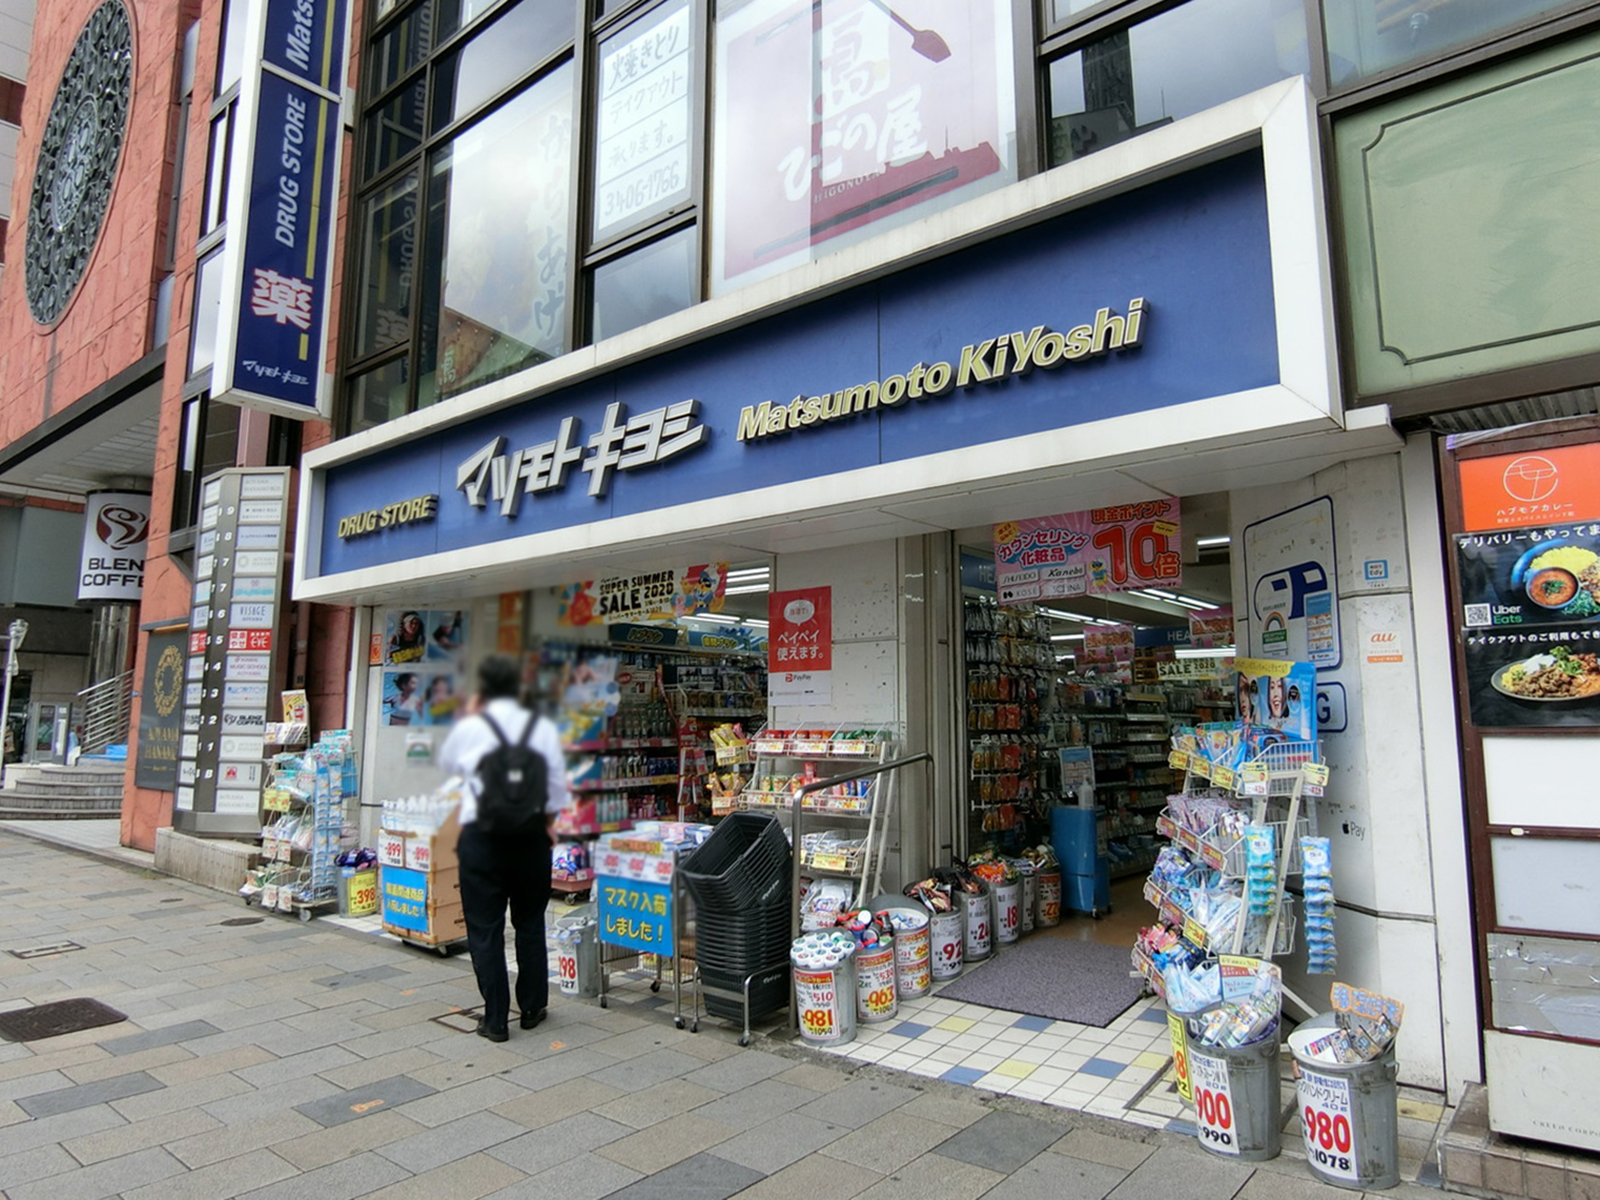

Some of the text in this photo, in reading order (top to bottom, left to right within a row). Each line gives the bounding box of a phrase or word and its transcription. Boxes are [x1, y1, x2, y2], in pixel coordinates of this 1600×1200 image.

[608, 26, 680, 91] 焼きとり
[609, 71, 683, 123] テイクアウト
[777, 84, 928, 202] ひごの屋
[275, 93, 308, 248] DRUG STORE
[251, 267, 314, 330] 薬
[242, 359, 310, 386] マツモトキヨシ
[736, 297, 1151, 443] Matsumoto KiYoshi
[456, 399, 711, 518] マツモトキヨシ
[337, 494, 438, 540] DRUG STORE
[1091, 500, 1171, 523] 現金ポイント
[998, 528, 1091, 561] カウンセリング
[88, 558, 145, 571] BLEN
[1020, 547, 1066, 567] 化粧品
[82, 574, 144, 588] COFF
[599, 570, 675, 596] SUPER SUMMER
[1048, 565, 1083, 578] Kanebo
[600, 588, 642, 616] SALE
[644, 583, 674, 599] 2020
[1492, 605, 1522, 615] Uber
[1493, 615, 1523, 625] Eats
[778, 629, 819, 644] ペイペイ
[1370, 632, 1396, 643] au
[777, 644, 824, 662] 使えます。
[1159, 660, 1216, 676] SALE 2020
[1350, 820, 1366, 842] Pay
[357, 886, 376, 905] 398
[604, 887, 667, 917] マスク入荷
[605, 914, 664, 942] しました！
[804, 1009, 833, 1027] 981
[1195, 1085, 1231, 1129] 900
[1202, 1126, 1231, 1145] 990
[1305, 1105, 1351, 1154] 980
[1314, 1148, 1350, 1171] 1078
